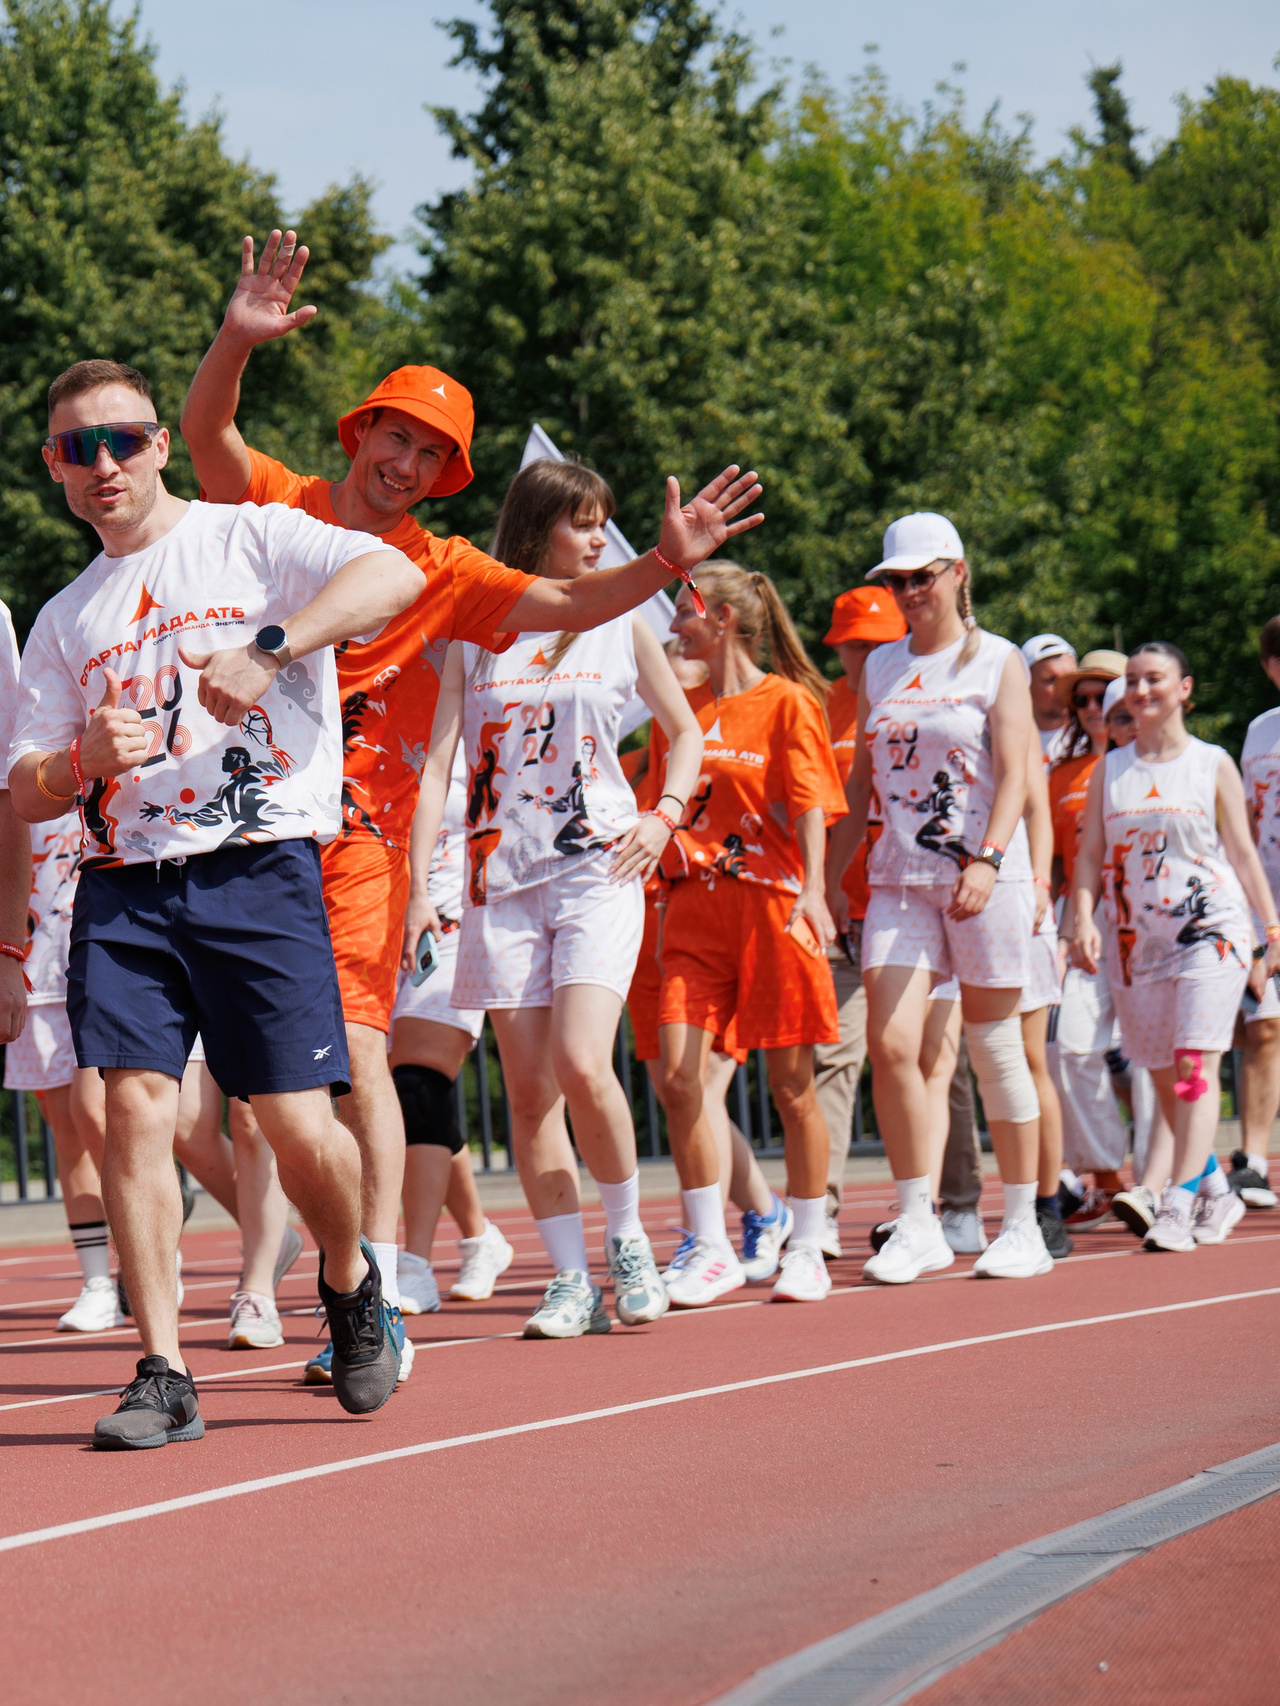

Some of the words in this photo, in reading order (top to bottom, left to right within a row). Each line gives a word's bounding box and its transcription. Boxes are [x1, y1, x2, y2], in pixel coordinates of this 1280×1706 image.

[204, 607, 245, 619] АТБ
[176, 622, 211, 634] КОМАНДА
[575, 671, 602, 680] АТБ
[128, 664, 183, 720] 20
[521, 701, 555, 736] 20
[140, 707, 193, 769] 26
[886, 721, 918, 745] 20
[522, 732, 558, 768] 26
[888, 745, 921, 771] 26
[1138, 828, 1167, 856] 20
[1140, 855, 1170, 881] 26
